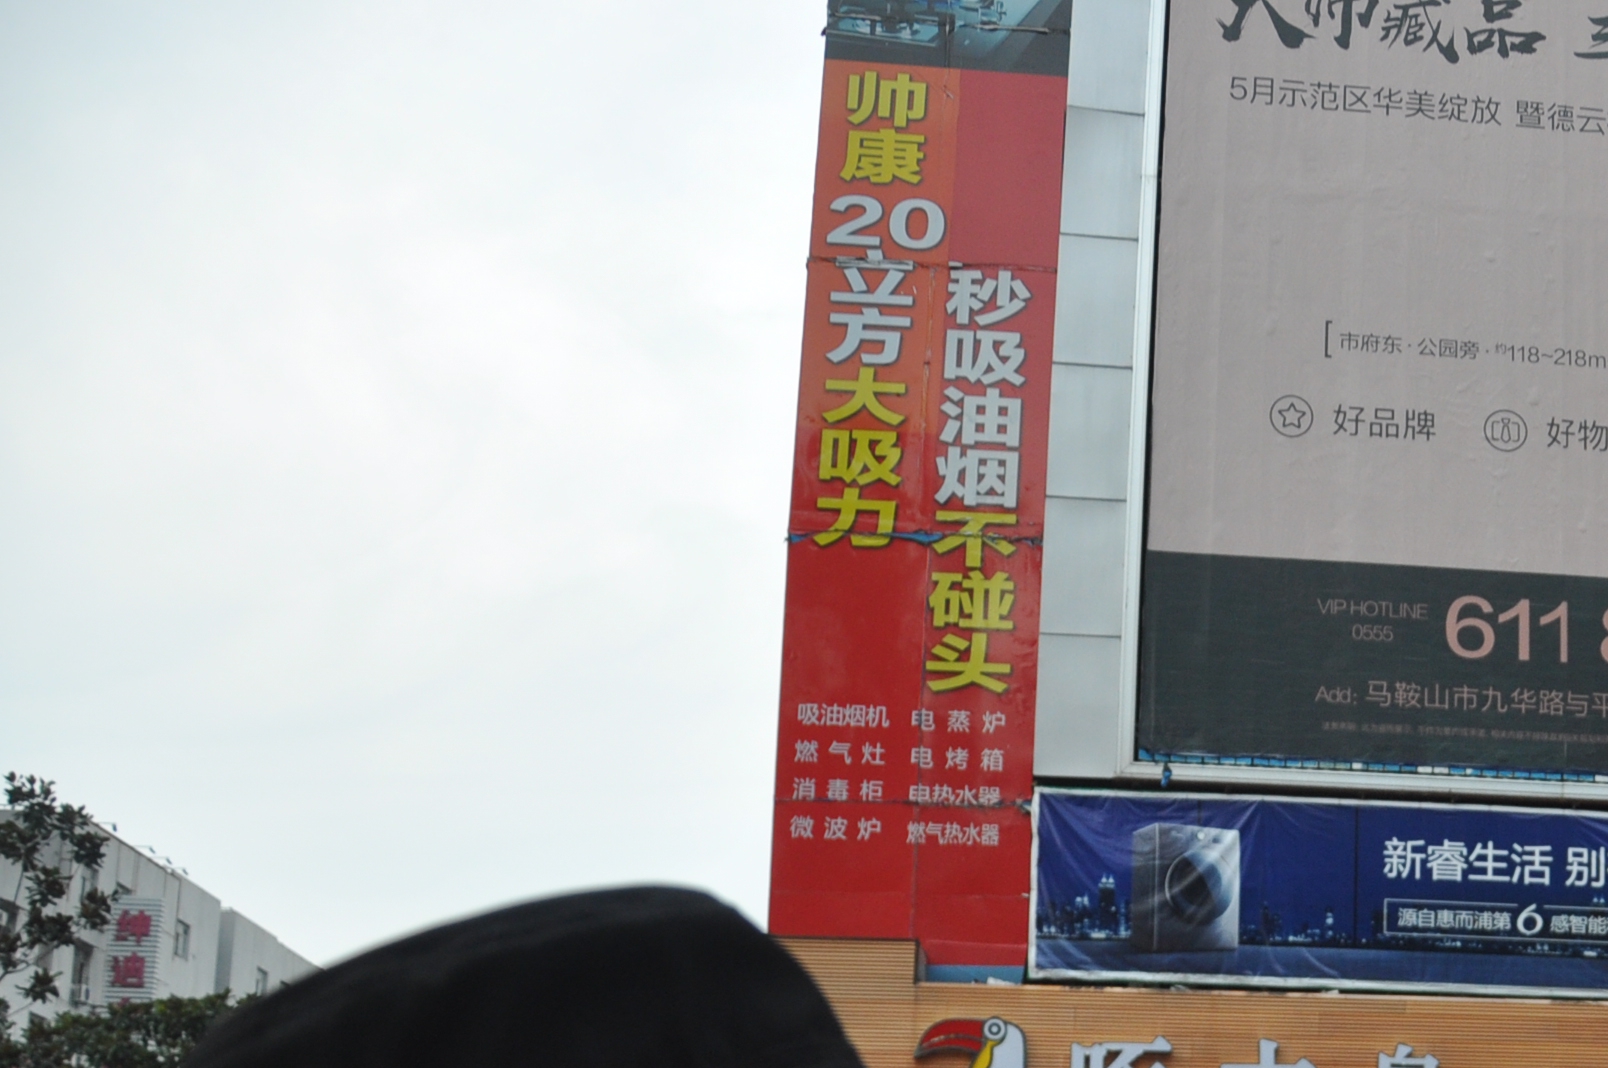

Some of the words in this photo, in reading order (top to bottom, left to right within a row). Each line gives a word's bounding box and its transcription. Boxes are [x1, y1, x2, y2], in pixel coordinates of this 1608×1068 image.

[1229, 76, 1503, 127] 5月示范区华美绽放
[1332, 403, 1437, 442] 好品牌
[924, 267, 1032, 694] 秒吸油烟不碰头
[1317, 598, 1347, 615] VIP
[1350, 600, 1429, 620] HOTLINE
[1351, 623, 1394, 642] 0555
[1445, 594, 1569, 664] 611
[797, 703, 890, 729] 吸油烟机
[911, 709, 1007, 734] 电蒸炉
[793, 741, 886, 766] 燃气灶
[910, 747, 1004, 772] 电烤箱
[791, 777, 884, 803] 消毒柜
[789, 815, 882, 841] 微波炉
[906, 821, 1000, 847] 燃气热水器
[1382, 836, 1554, 886] 新睿生活
